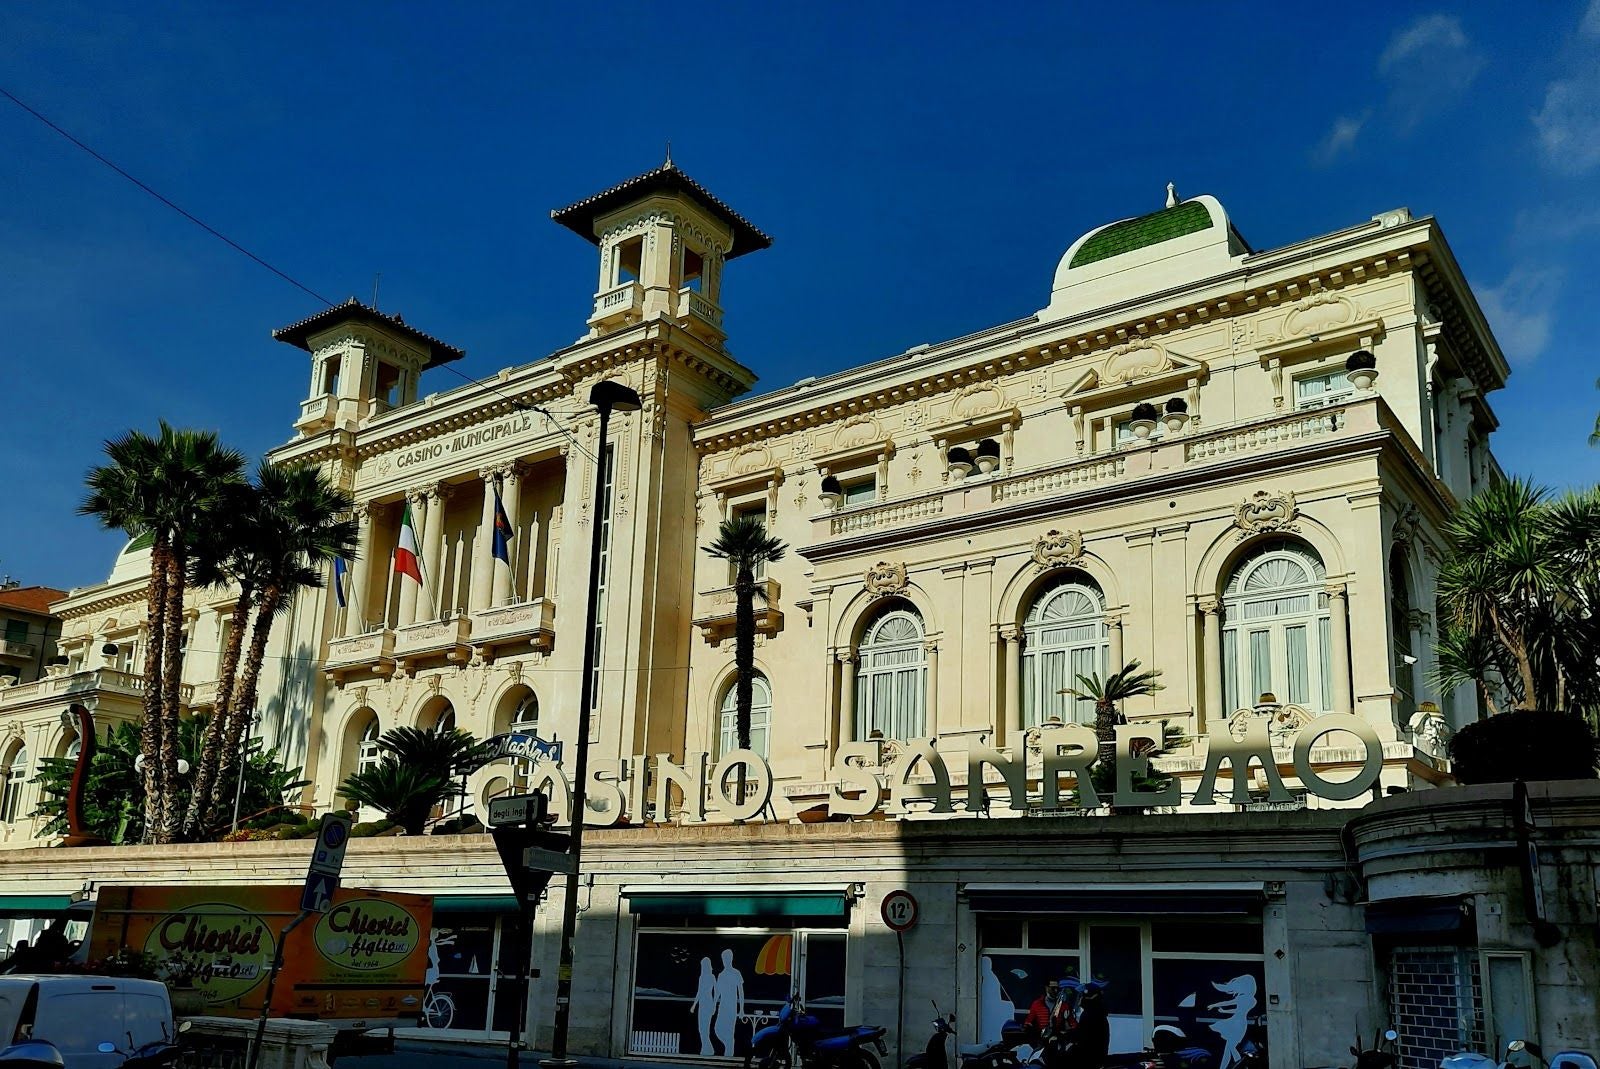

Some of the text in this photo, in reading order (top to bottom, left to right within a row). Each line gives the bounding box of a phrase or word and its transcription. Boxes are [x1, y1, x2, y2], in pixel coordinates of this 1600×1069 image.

[397, 416, 532, 468] CASINO MUNICIPALE
[474, 713, 1383, 828] CASINO SANREMO
[493, 807, 510, 819] degli
[160, 914, 262, 954] Chierici
[328, 905, 409, 936] Chierici
